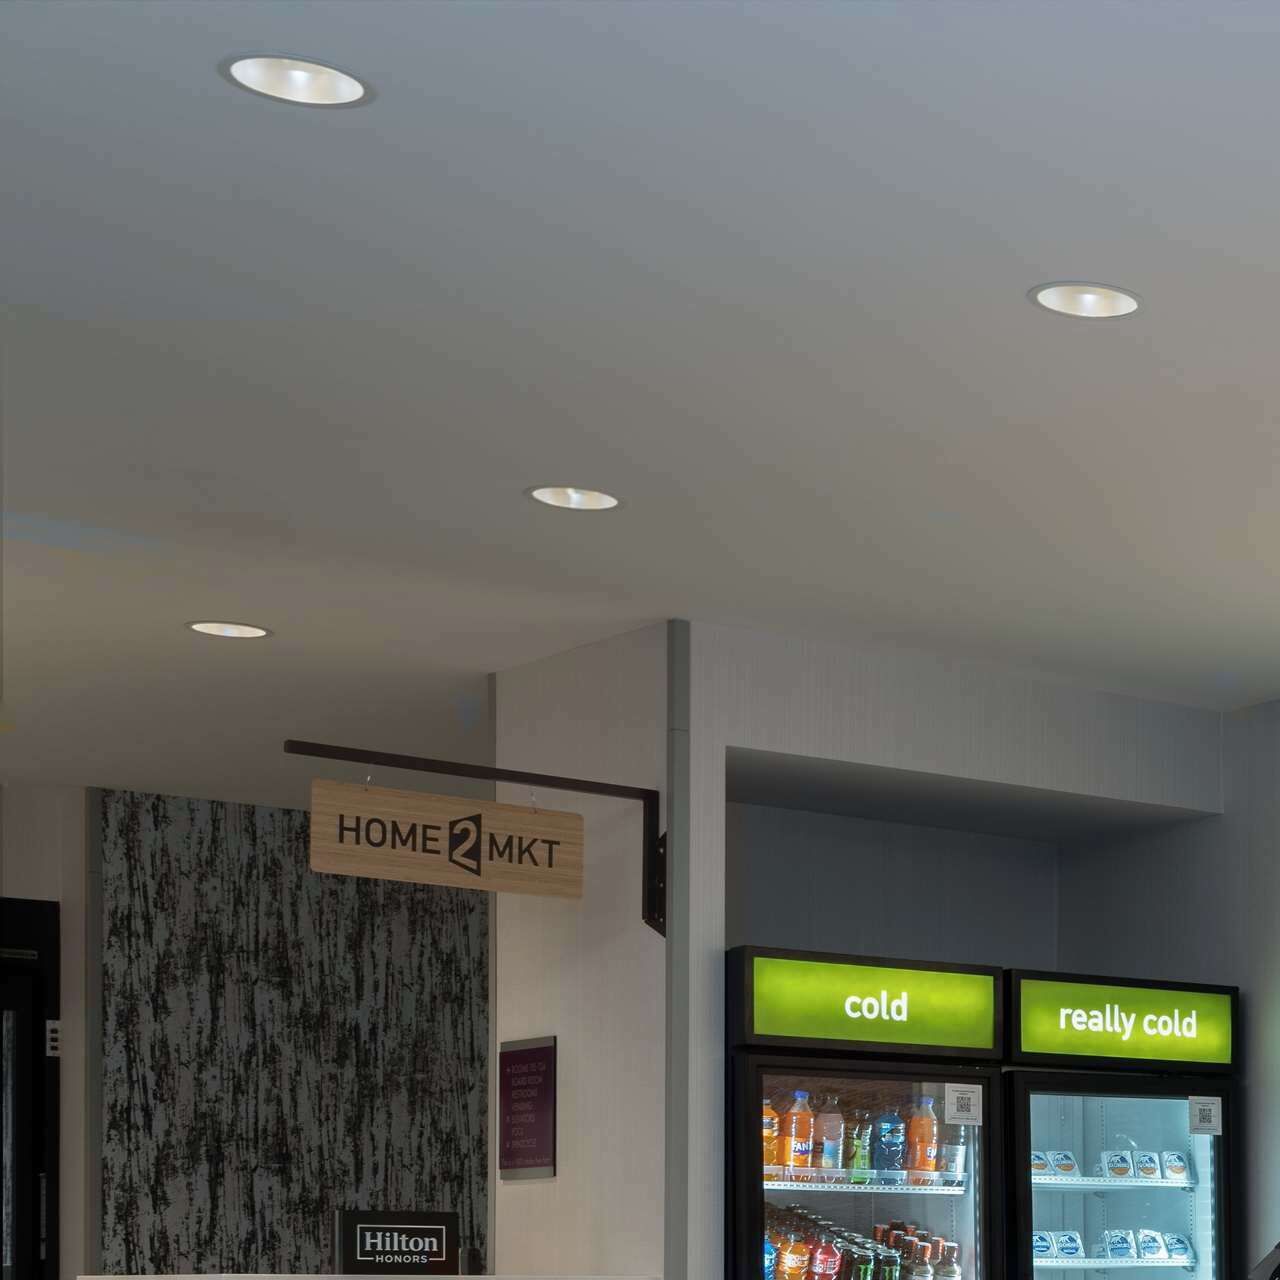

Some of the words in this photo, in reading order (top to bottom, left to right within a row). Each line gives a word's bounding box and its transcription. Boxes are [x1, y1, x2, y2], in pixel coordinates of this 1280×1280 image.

[488, 833, 561, 869] MKT
[844, 990, 908, 1022] cold
[1059, 1003, 1136, 1041] really
[1142, 1008, 1198, 1038] cold
[364, 1231, 439, 1252] Hilton
[375, 1254, 428, 1264] HONORS
